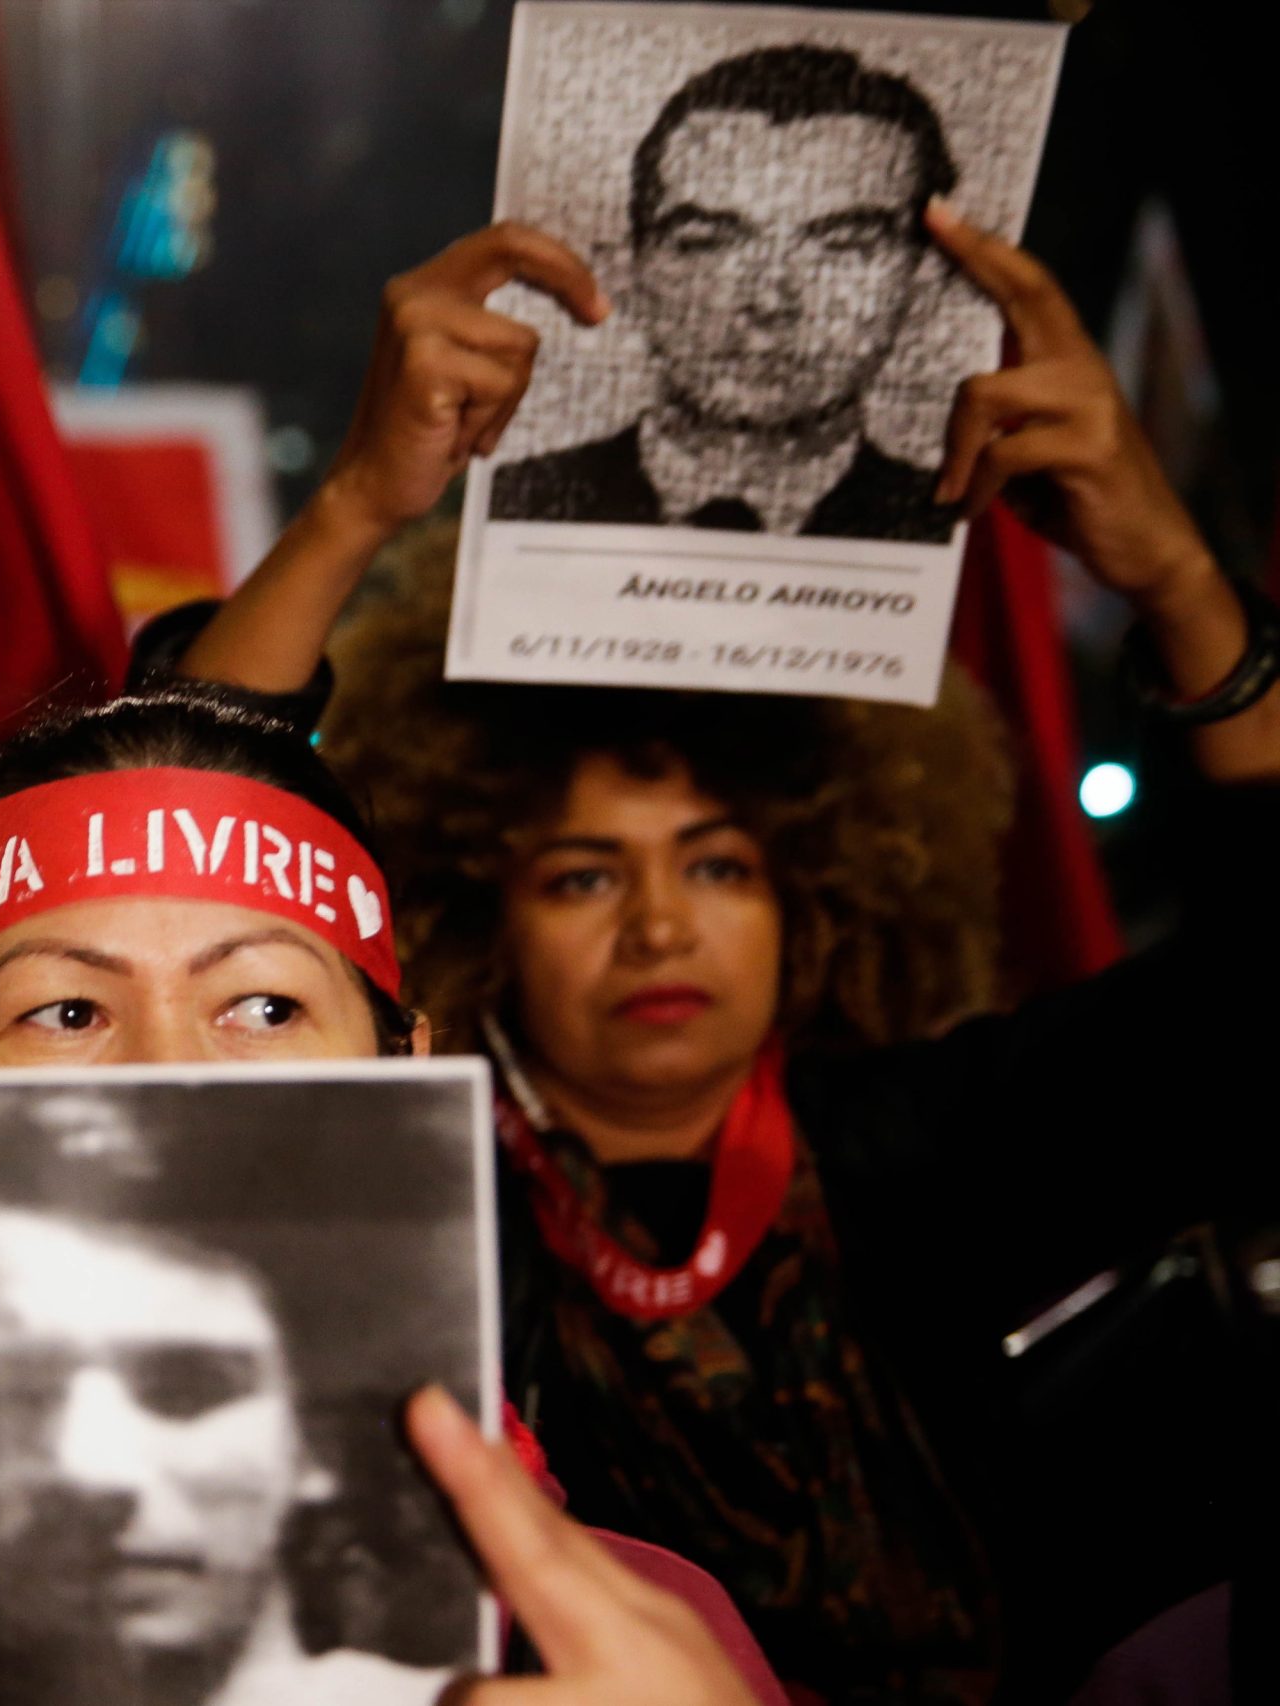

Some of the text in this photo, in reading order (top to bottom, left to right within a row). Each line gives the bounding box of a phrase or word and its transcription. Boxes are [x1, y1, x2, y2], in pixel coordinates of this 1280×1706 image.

[765, 584, 916, 616] ARROYO
[508, 634, 684, 664] 6/11/1928
[710, 642, 904, 679] 16/12/1976
[84, 807, 337, 923] LIVRE
